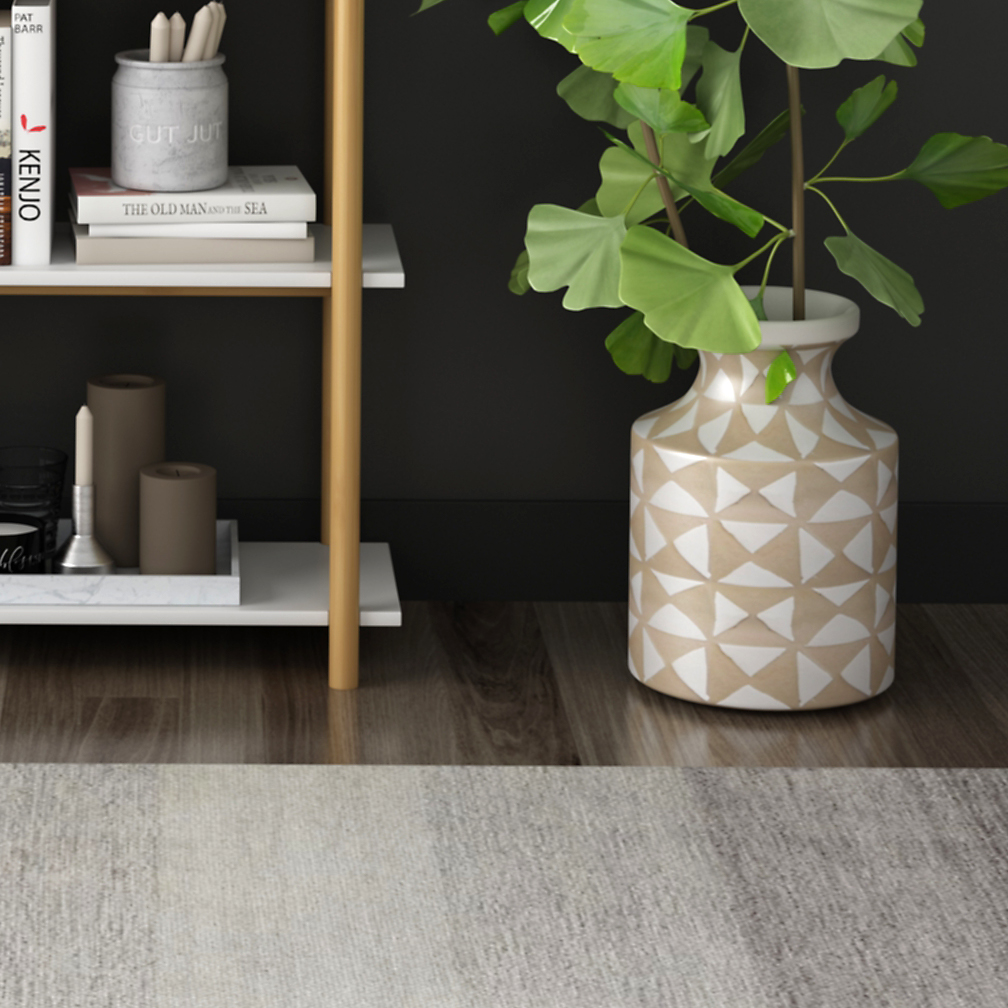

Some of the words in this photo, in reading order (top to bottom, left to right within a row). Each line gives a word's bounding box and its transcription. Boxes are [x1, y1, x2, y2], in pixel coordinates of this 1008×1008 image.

[14, 13, 34, 22] PAT
[14, 24, 43, 33] BARR
[129, 124, 180, 144] GUT
[18, 150, 41, 222] KENJO
[122, 203, 148, 216] THE
[150, 202, 178, 216] OLD
[179, 202, 207, 216] MAN
[207, 205, 225, 215] AND
[226, 205, 242, 214] THE
[244, 201, 268, 215] SEA
